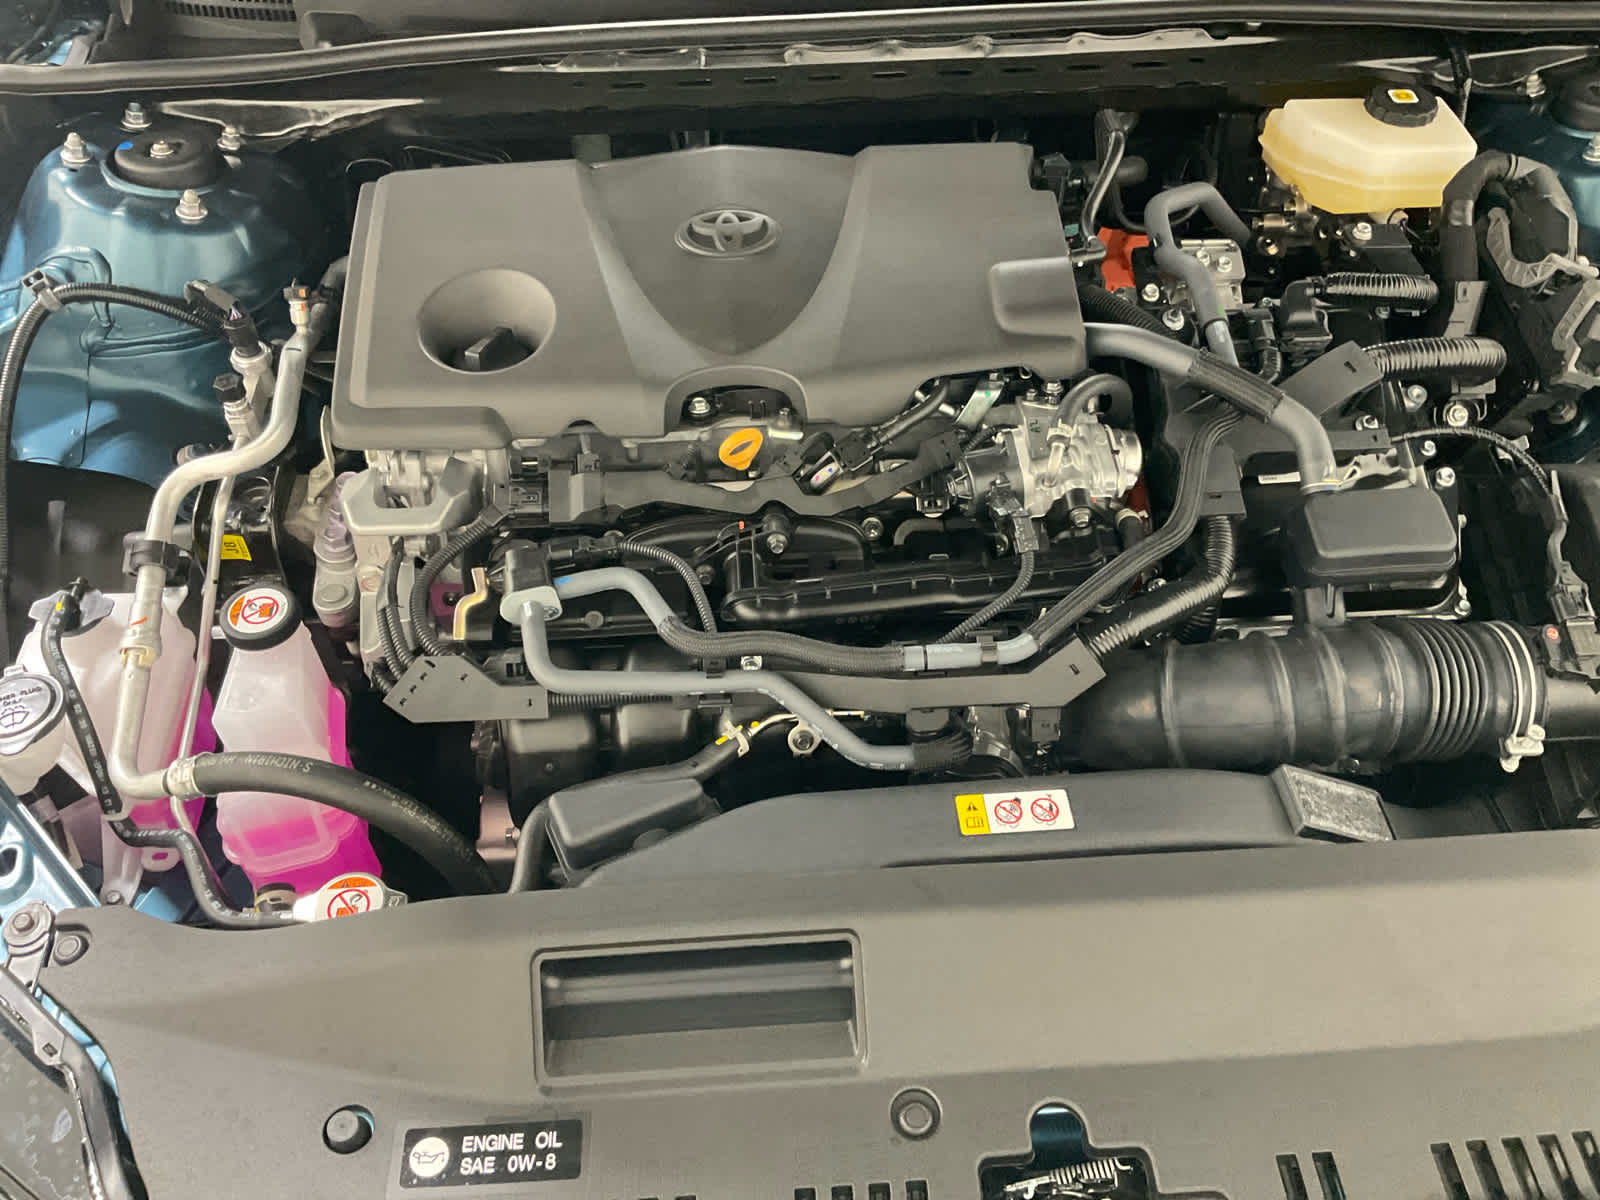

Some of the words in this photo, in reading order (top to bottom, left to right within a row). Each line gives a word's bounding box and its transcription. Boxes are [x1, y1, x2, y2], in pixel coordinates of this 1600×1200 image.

[462, 1133, 525, 1153] ENGINE
[535, 1131, 563, 1149] OIL
[460, 1156, 496, 1176] SAE
[507, 1153, 557, 1173] 0W-8
